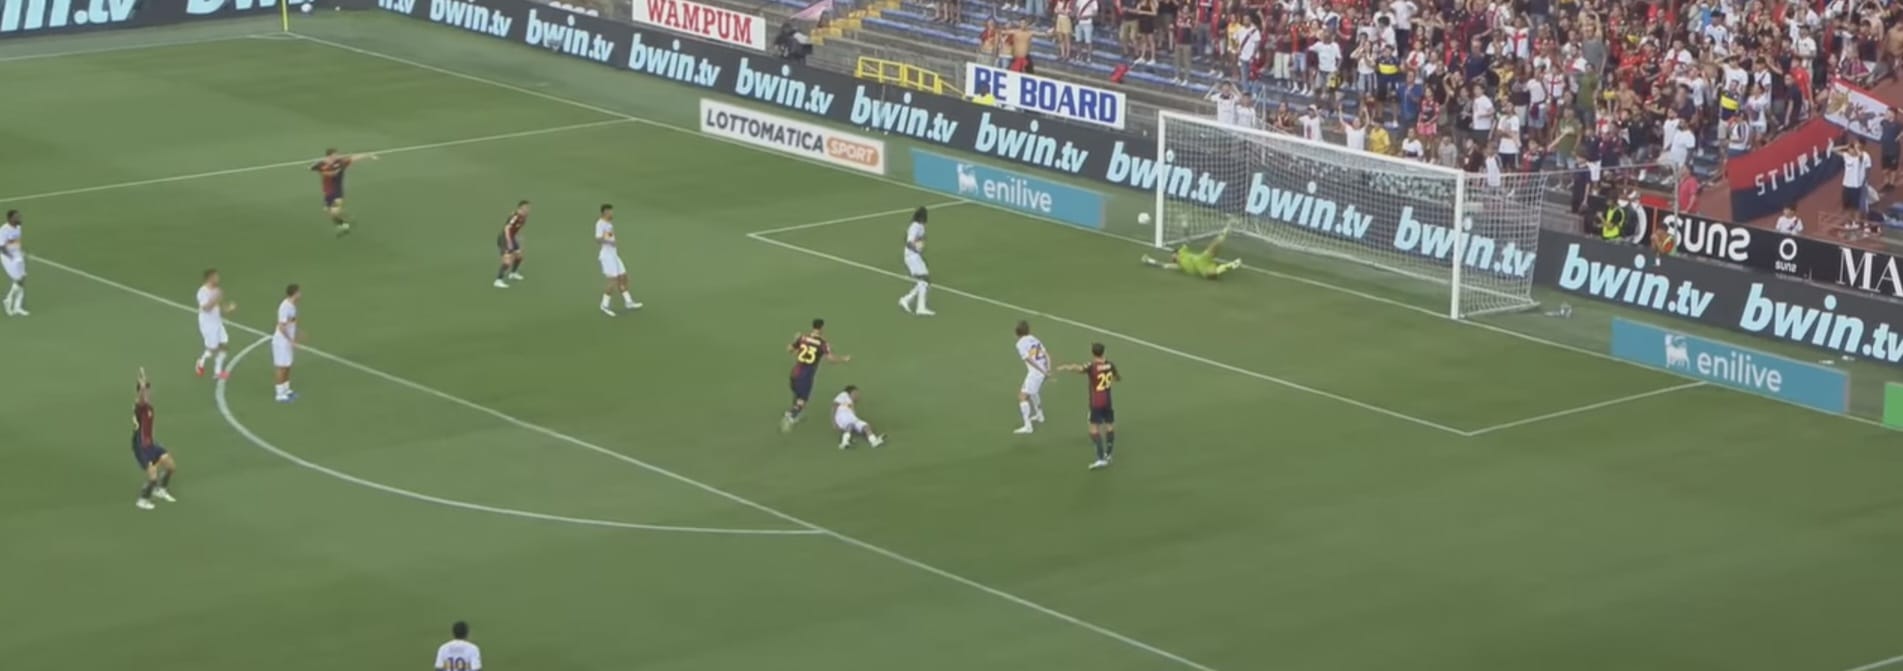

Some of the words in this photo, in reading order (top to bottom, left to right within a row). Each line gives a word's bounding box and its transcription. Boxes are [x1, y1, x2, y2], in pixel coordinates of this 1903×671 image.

[429, 0, 512, 37] bwin.tv
[526, 9, 614, 62] bwin.tv
[648, 0, 752, 43] WAMPUM
[628, 33, 721, 87] bwin.tv
[735, 58, 833, 115] bwin.tv
[850, 86, 958, 143] bwin.tv
[974, 68, 1007, 100] BE
[1019, 77, 1117, 123] BOARD
[706, 108, 824, 153] LOTTOMATICA
[829, 139, 876, 164] SPORT
[975, 115, 1088, 174] bwin.tv
[983, 177, 1052, 213] enilive
[1106, 141, 1226, 205] bwin.tv
[1245, 172, 1374, 239] bwin.tv
[1394, 206, 1537, 277] bwin.tv
[1559, 244, 1714, 318] bwin.tv
[1836, 247, 1903, 297] MA
[1697, 352, 1782, 392] enilive
